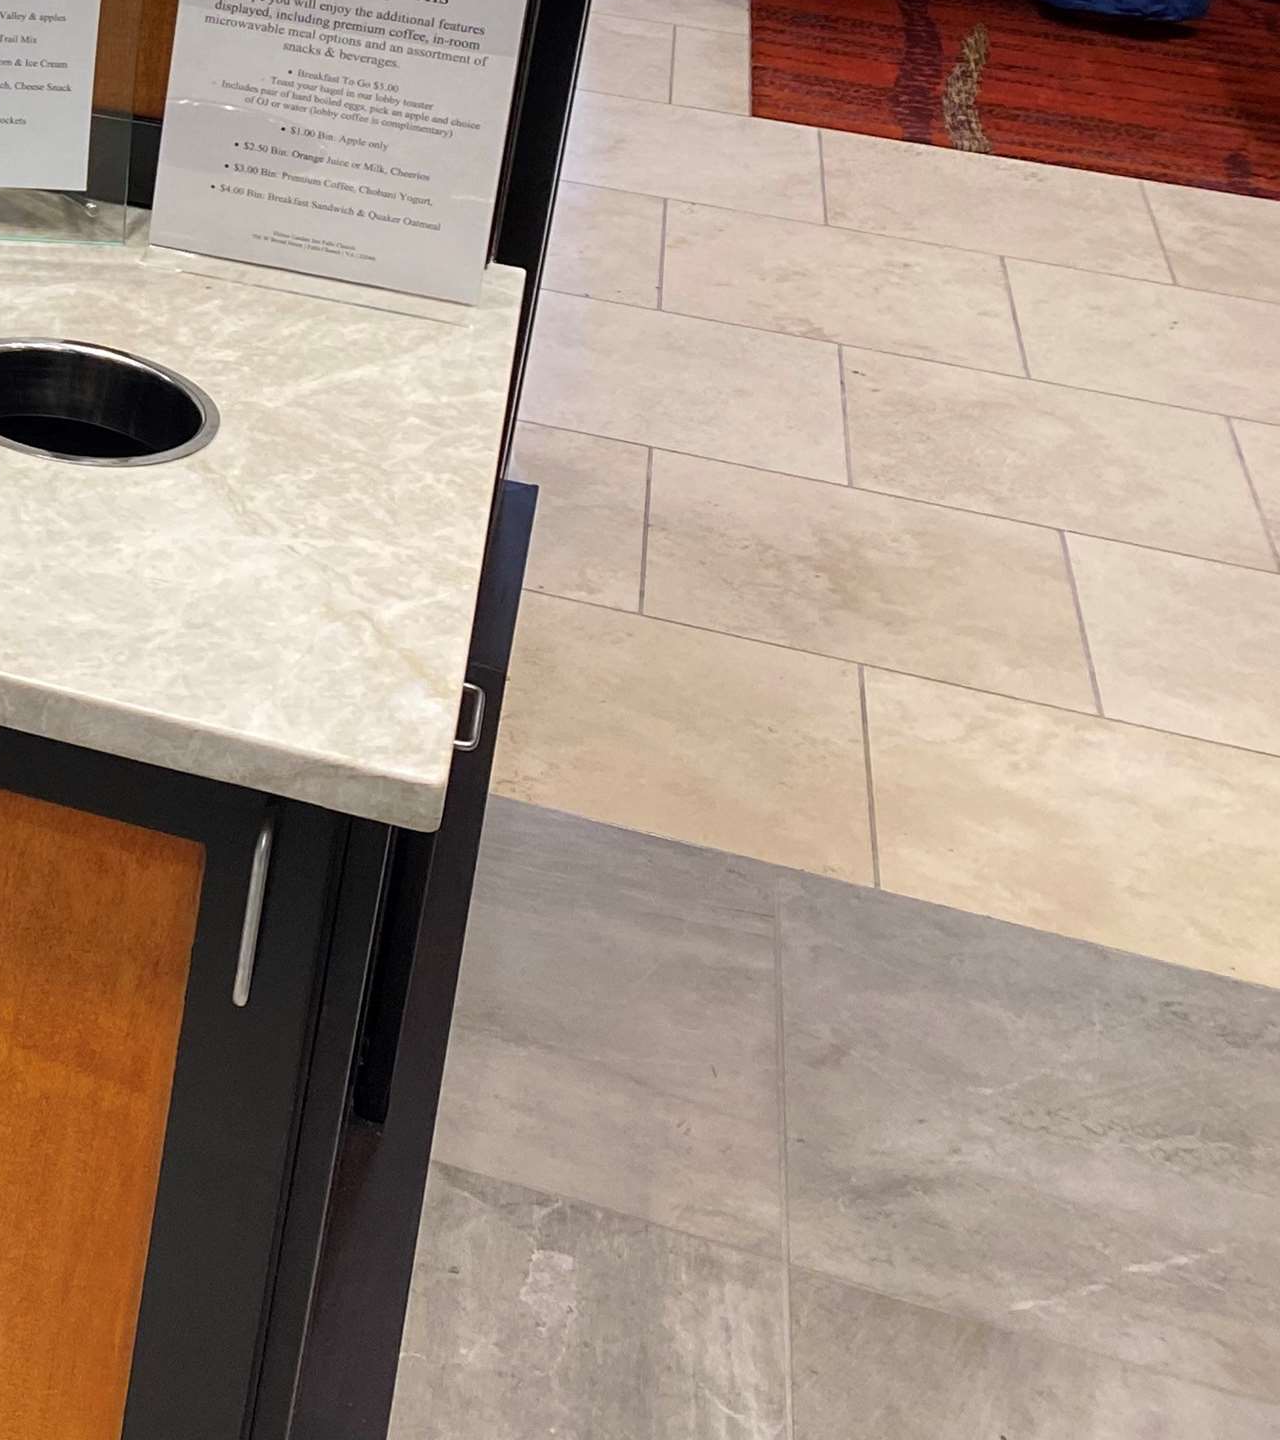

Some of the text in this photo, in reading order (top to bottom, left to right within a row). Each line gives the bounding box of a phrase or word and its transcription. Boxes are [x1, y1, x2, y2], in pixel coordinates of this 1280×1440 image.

[215, 0, 480, 50] displayed, including premium coffee, in-room
[319, 1, 352, 17] enjoy
[354, 5, 373, 17] the
[375, 9, 435, 27] additional
[439, 18, 485, 35] features
[204, 14, 489, 66] microwavable meal options and an assortment of
[283, 41, 399, 68] snacks beverages.
[292, 150, 324, 164] Orange
[390, 166, 430, 181] Cheerios
[267, 192, 309, 208] Breakfast
[403, 216, 441, 231] Oatmeal
[399, 191, 433, 207] Yogurt,
